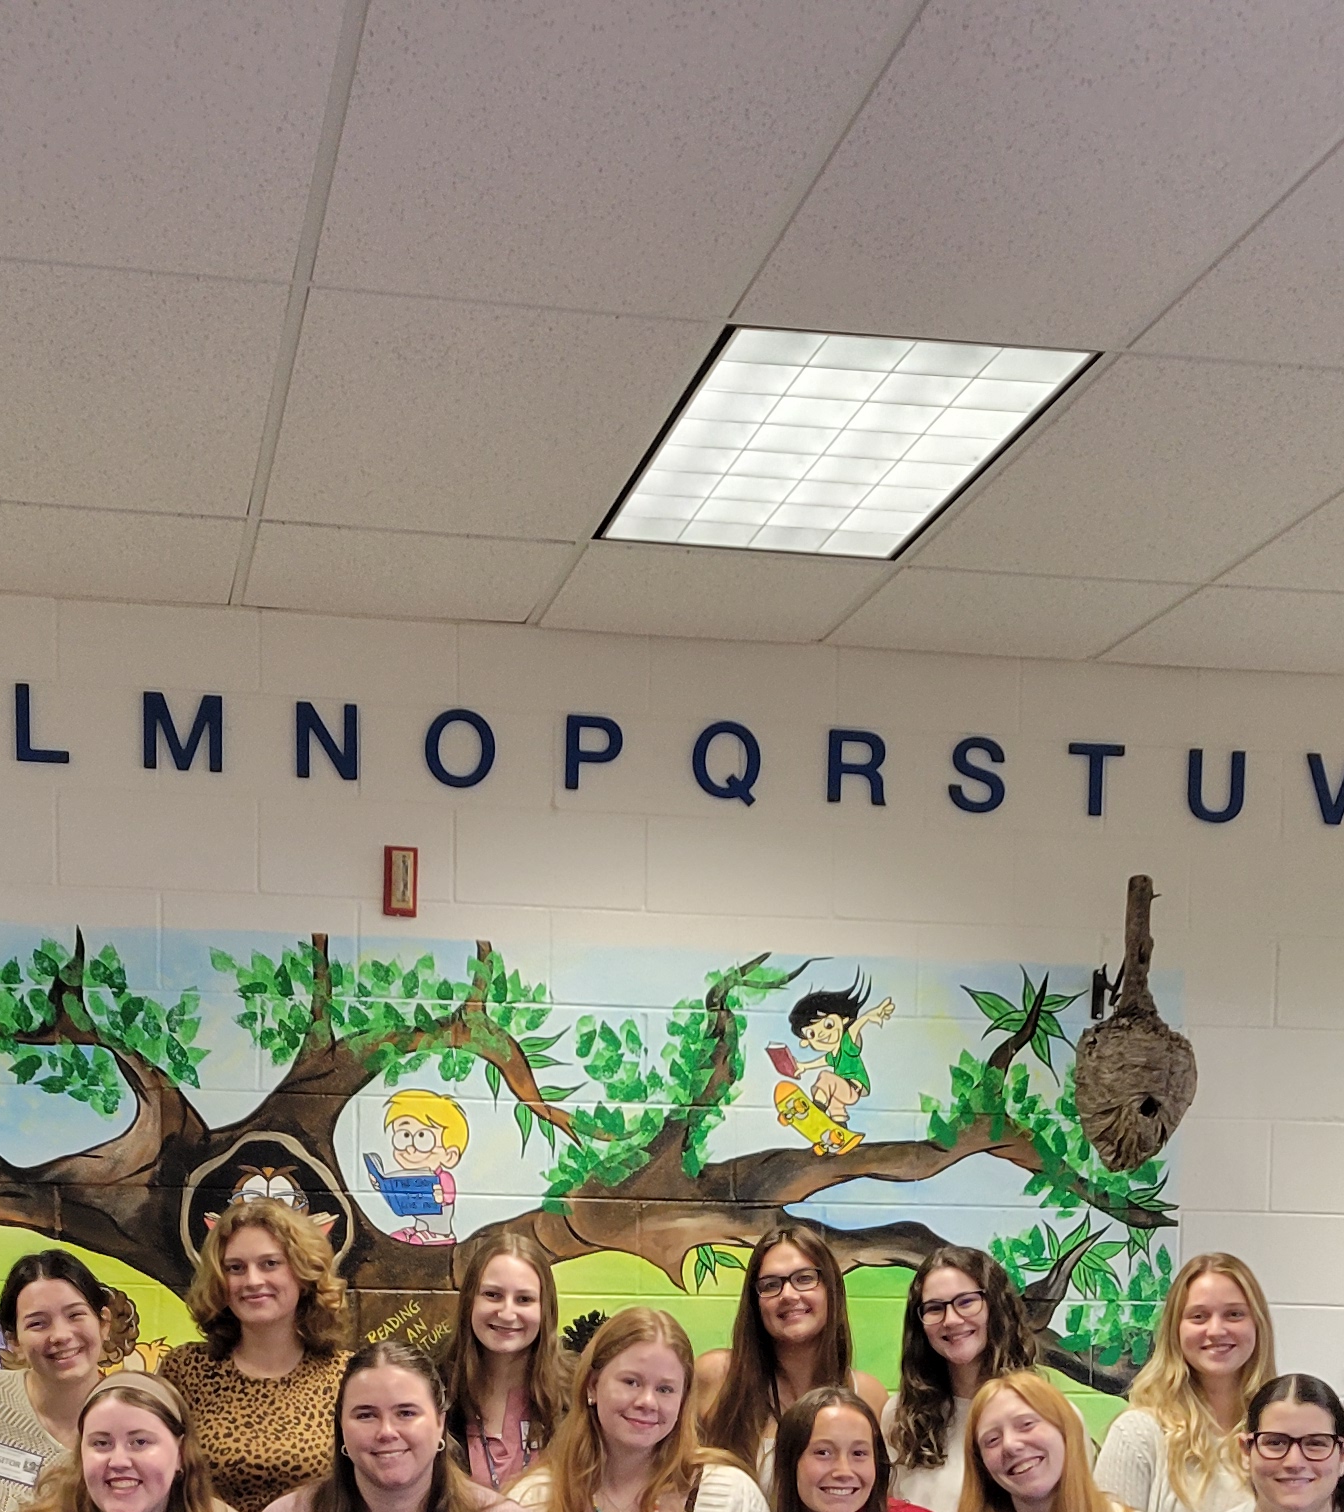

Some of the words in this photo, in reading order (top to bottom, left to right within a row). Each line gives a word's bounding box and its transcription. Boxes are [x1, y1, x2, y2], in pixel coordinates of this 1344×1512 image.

[15, 683, 70, 764] L
[143, 691, 223, 773] M
[295, 701, 358, 781] N
[424, 708, 496, 789] O
[564, 714, 624, 790] P
[691, 720, 761, 807] Q
[826, 728, 886, 807] R
[948, 736, 1006, 814] S
[1068, 742, 1126, 817] T
[1187, 748, 1246, 824] U
[365, 1299, 422, 1344] READING
[406, 1317, 428, 1344] AN
